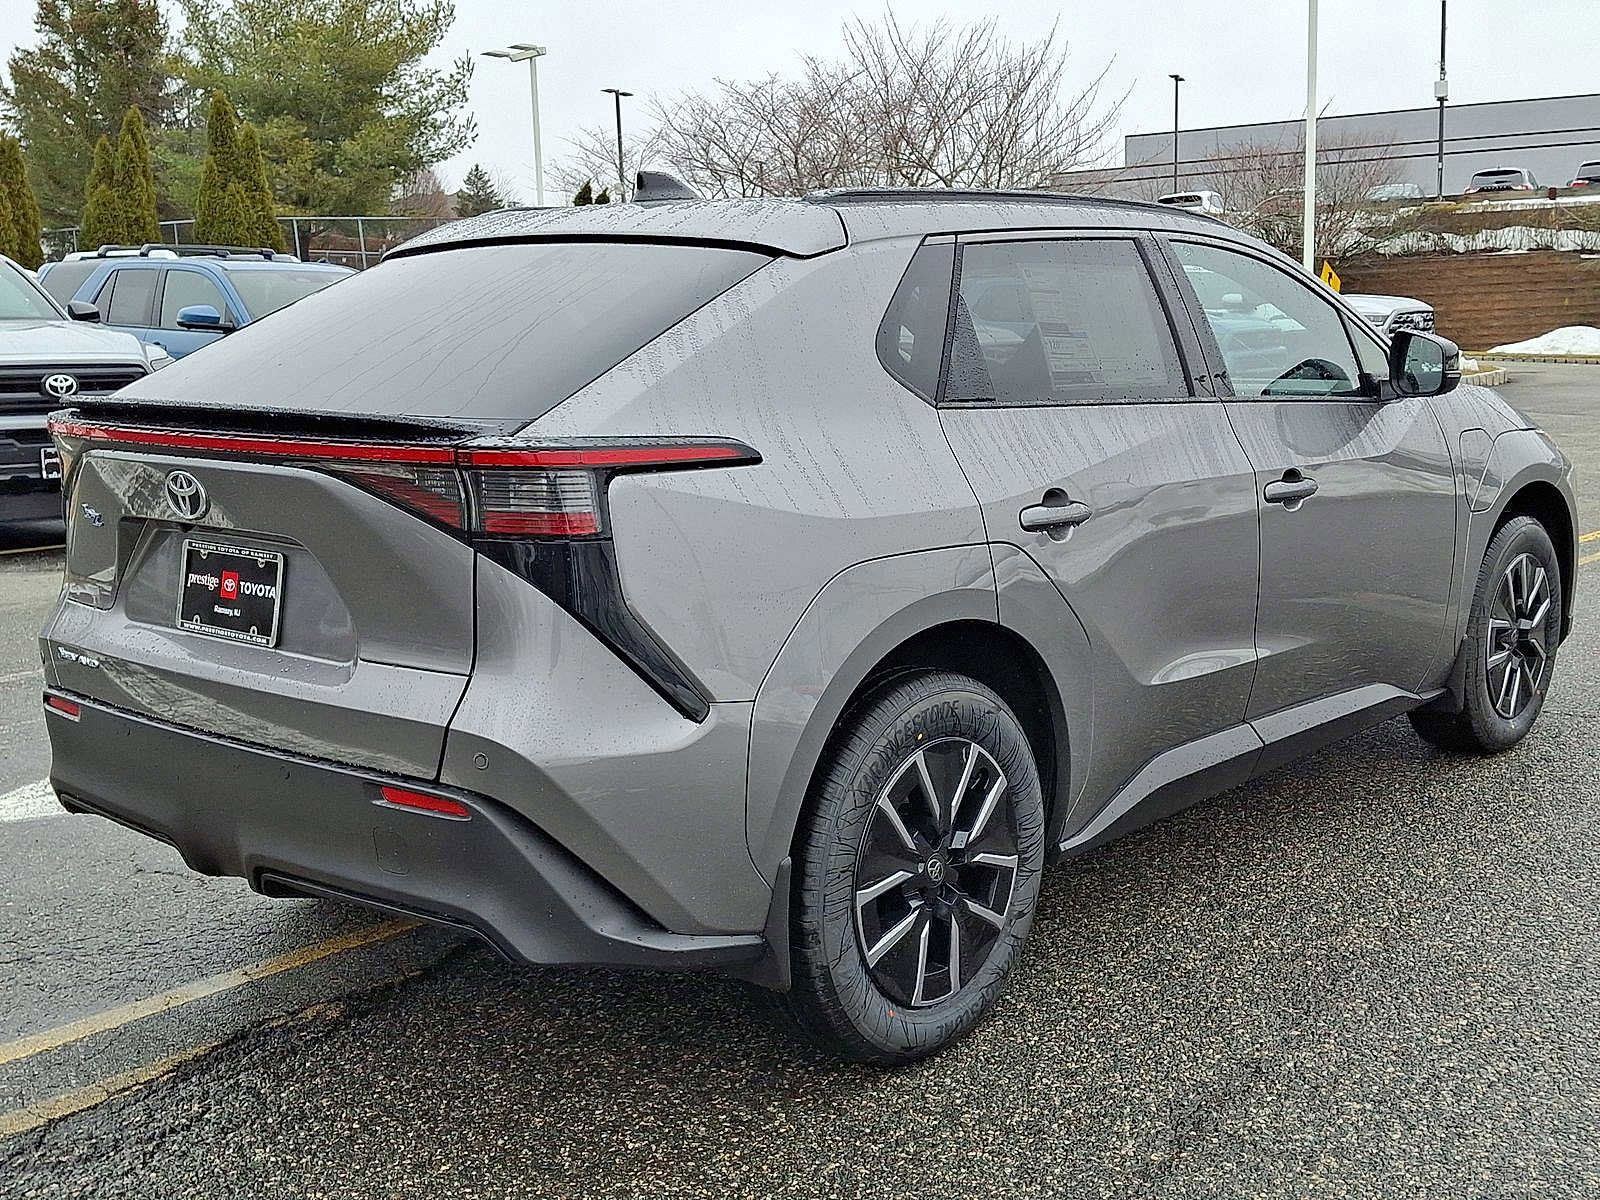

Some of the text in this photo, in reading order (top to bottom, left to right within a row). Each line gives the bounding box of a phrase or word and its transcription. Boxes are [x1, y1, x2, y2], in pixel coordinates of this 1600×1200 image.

[218, 546, 240, 555] TOYOTA
[187, 572, 277, 599] prestige TOYOTA
